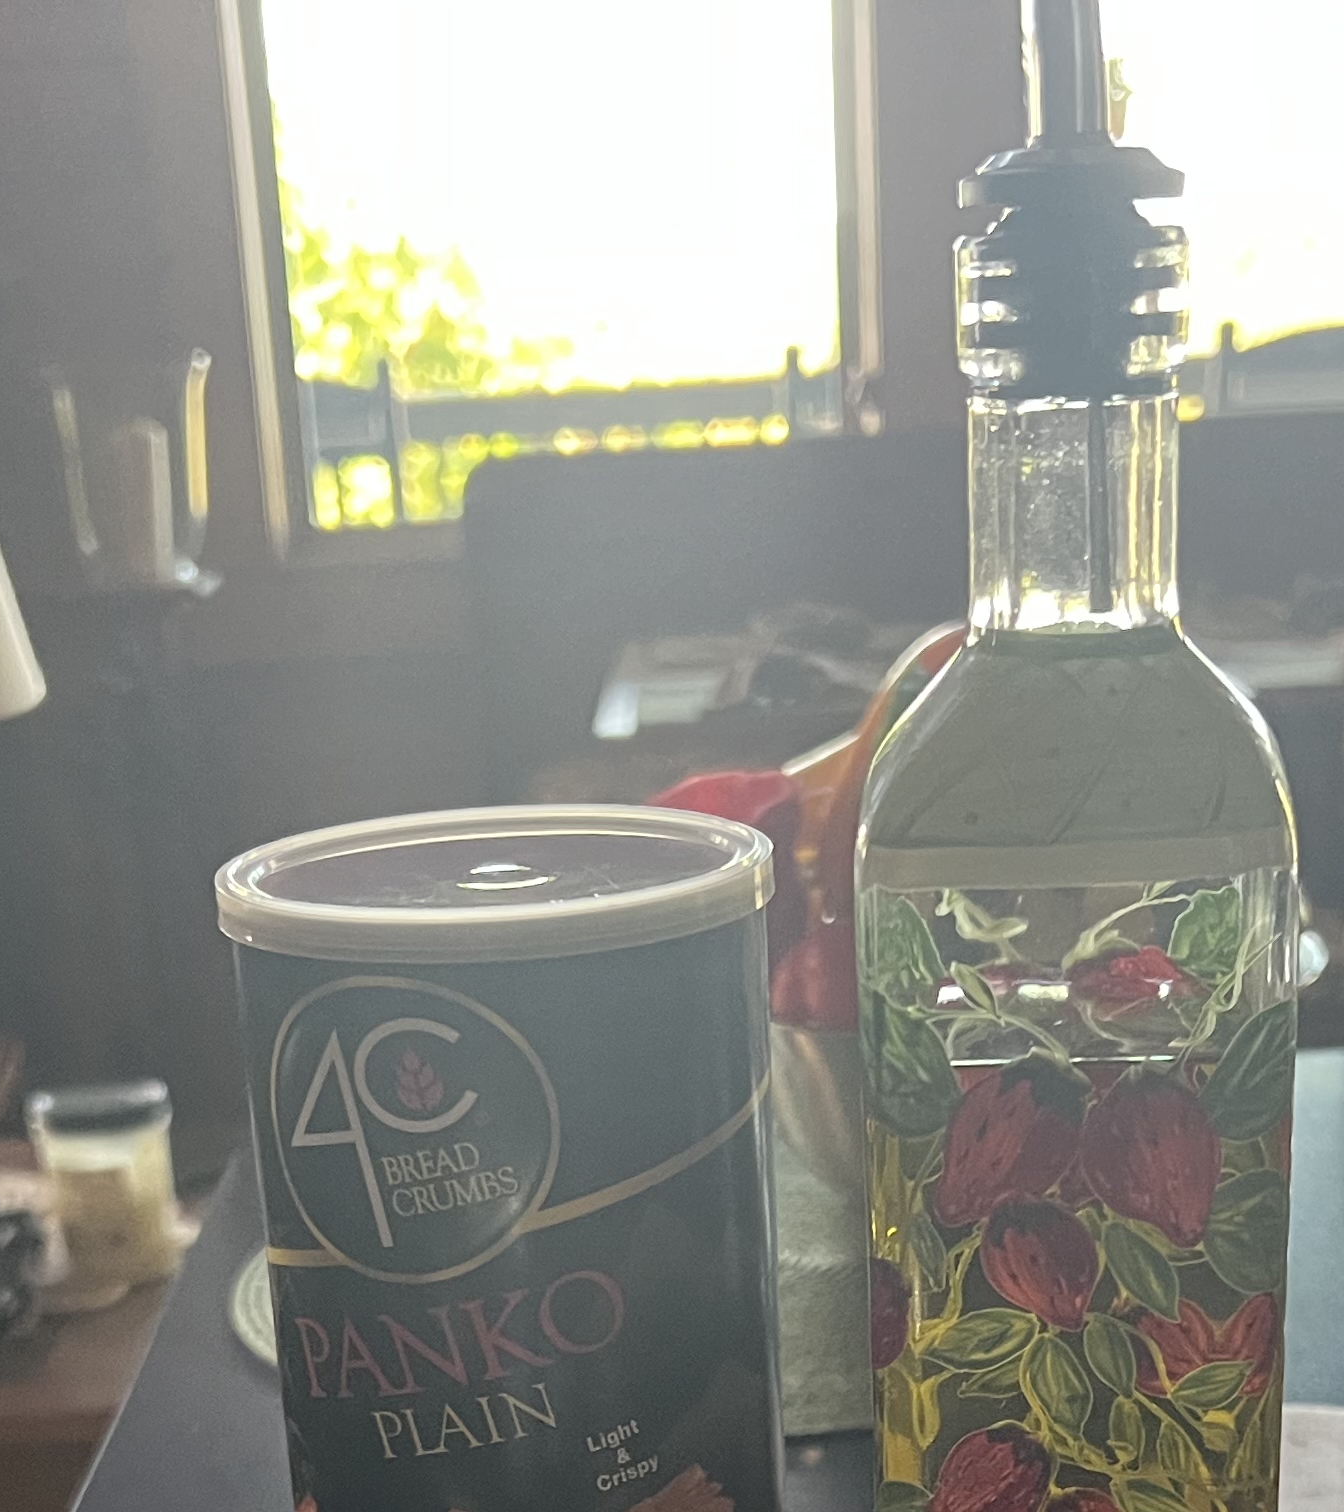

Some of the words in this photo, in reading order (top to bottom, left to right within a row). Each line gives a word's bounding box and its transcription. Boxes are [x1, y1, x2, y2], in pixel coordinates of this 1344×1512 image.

[381, 1142, 480, 1185] BREAD
[392, 1166, 519, 1217] CRUMBS
[294, 1270, 626, 1399] PANKO
[371, 1383, 557, 1459] PLAIN
[586, 1420, 640, 1453] Light
[596, 1454, 659, 1491] Crispy
[616, 1447, 631, 1464] &
